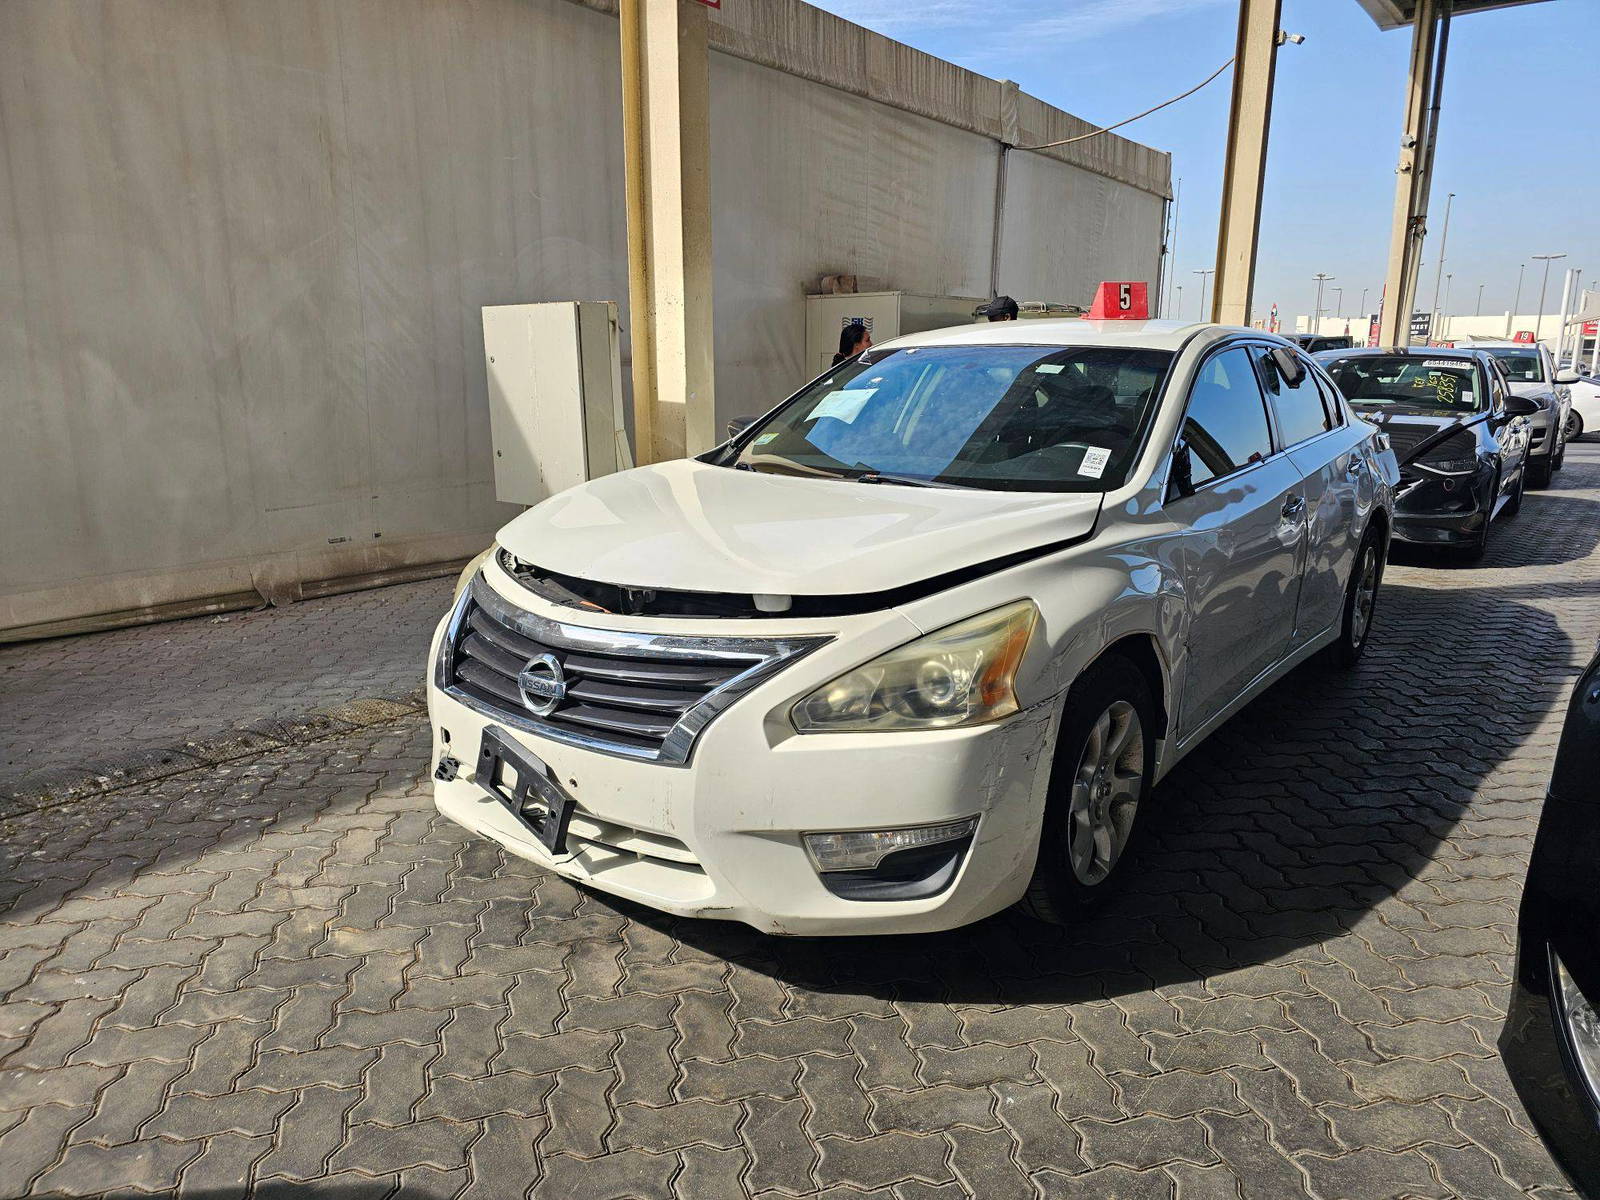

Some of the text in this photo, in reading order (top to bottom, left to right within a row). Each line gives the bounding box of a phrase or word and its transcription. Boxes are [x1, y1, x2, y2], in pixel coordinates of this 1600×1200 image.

[1119, 284, 1131, 310] 5
[1520, 331, 1529, 341] 19
[519, 676, 557, 694] NISSAN
